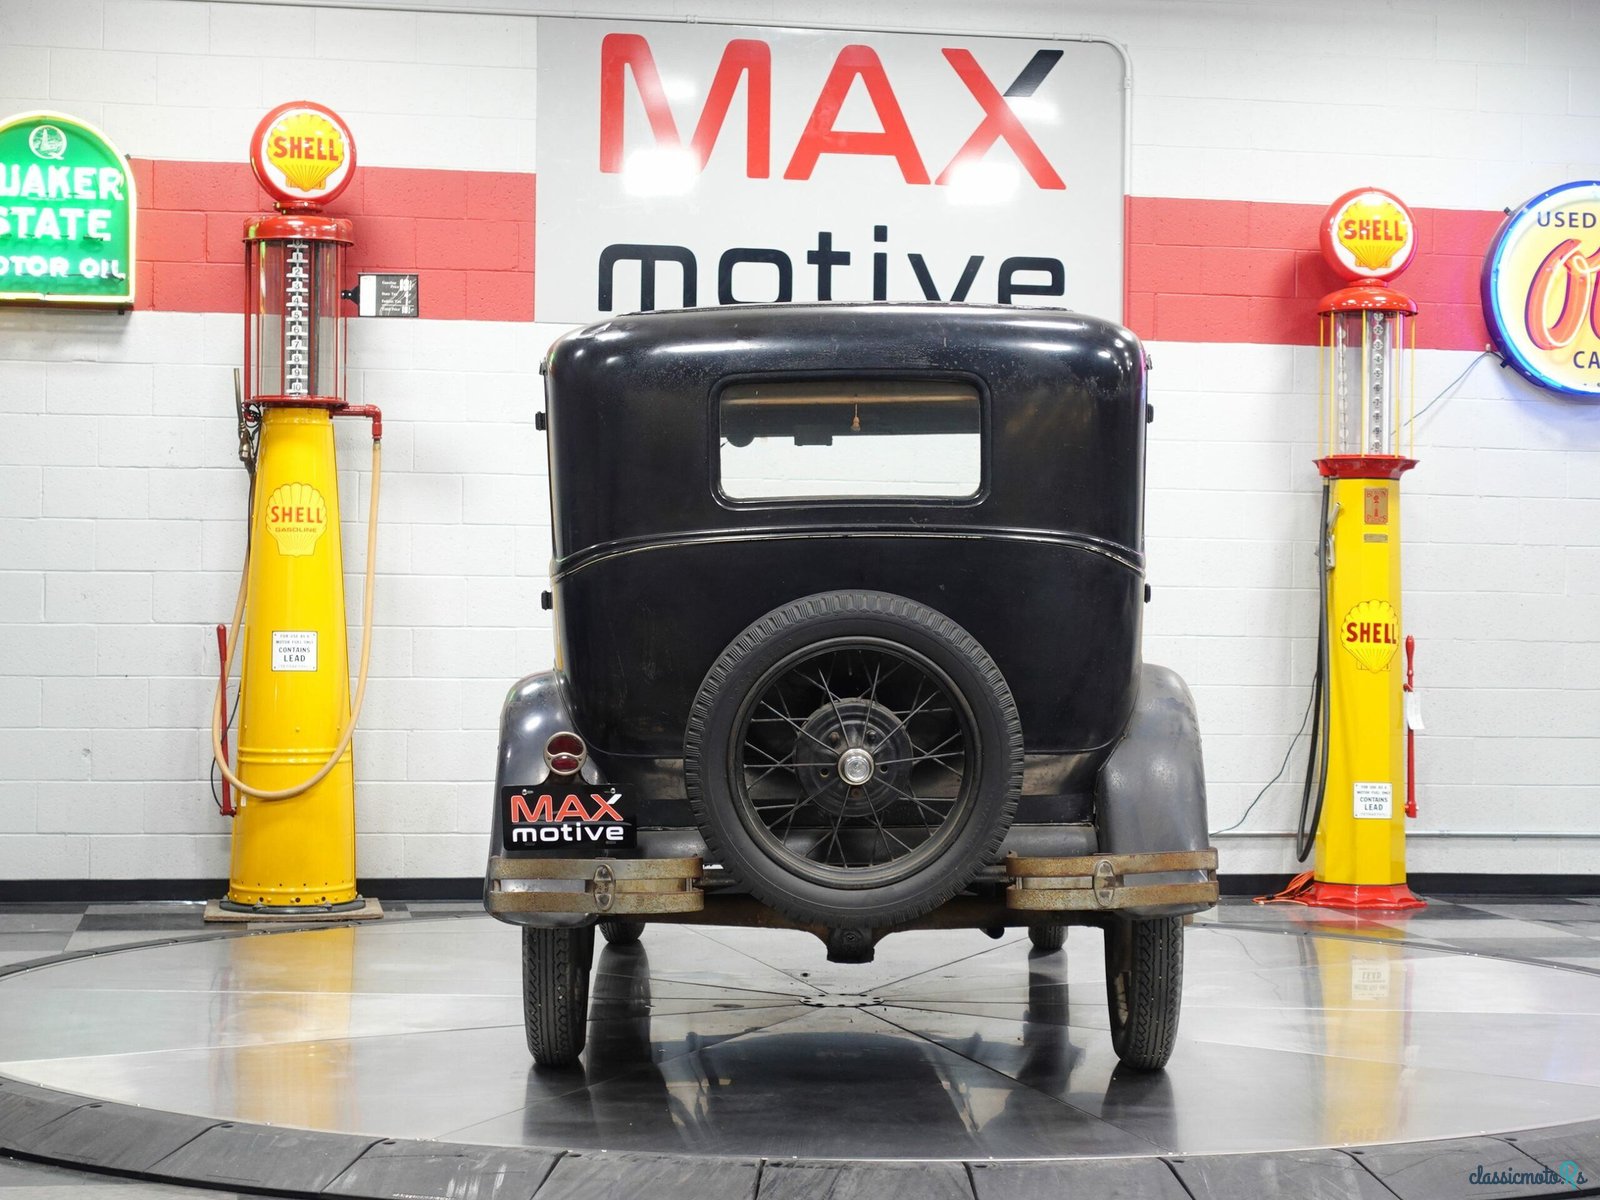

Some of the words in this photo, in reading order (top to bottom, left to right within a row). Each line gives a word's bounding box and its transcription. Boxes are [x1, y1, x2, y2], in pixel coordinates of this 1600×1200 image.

[600, 33, 1067, 190] MAX
[273, 136, 339, 162] SHELL
[1343, 219, 1404, 241] SHELL
[1537, 211, 1597, 229] USED
[79, 257, 126, 280] OIL
[598, 225, 1065, 311] motive
[271, 505, 323, 523] SHELL
[1346, 622, 1397, 645] SHELL
[278, 646, 311, 654] CONTAINS
[283, 654, 306, 663] LEAD
[510, 794, 624, 823] MAX
[1364, 803, 1384, 811] LEAD
[512, 822, 624, 842] motive
